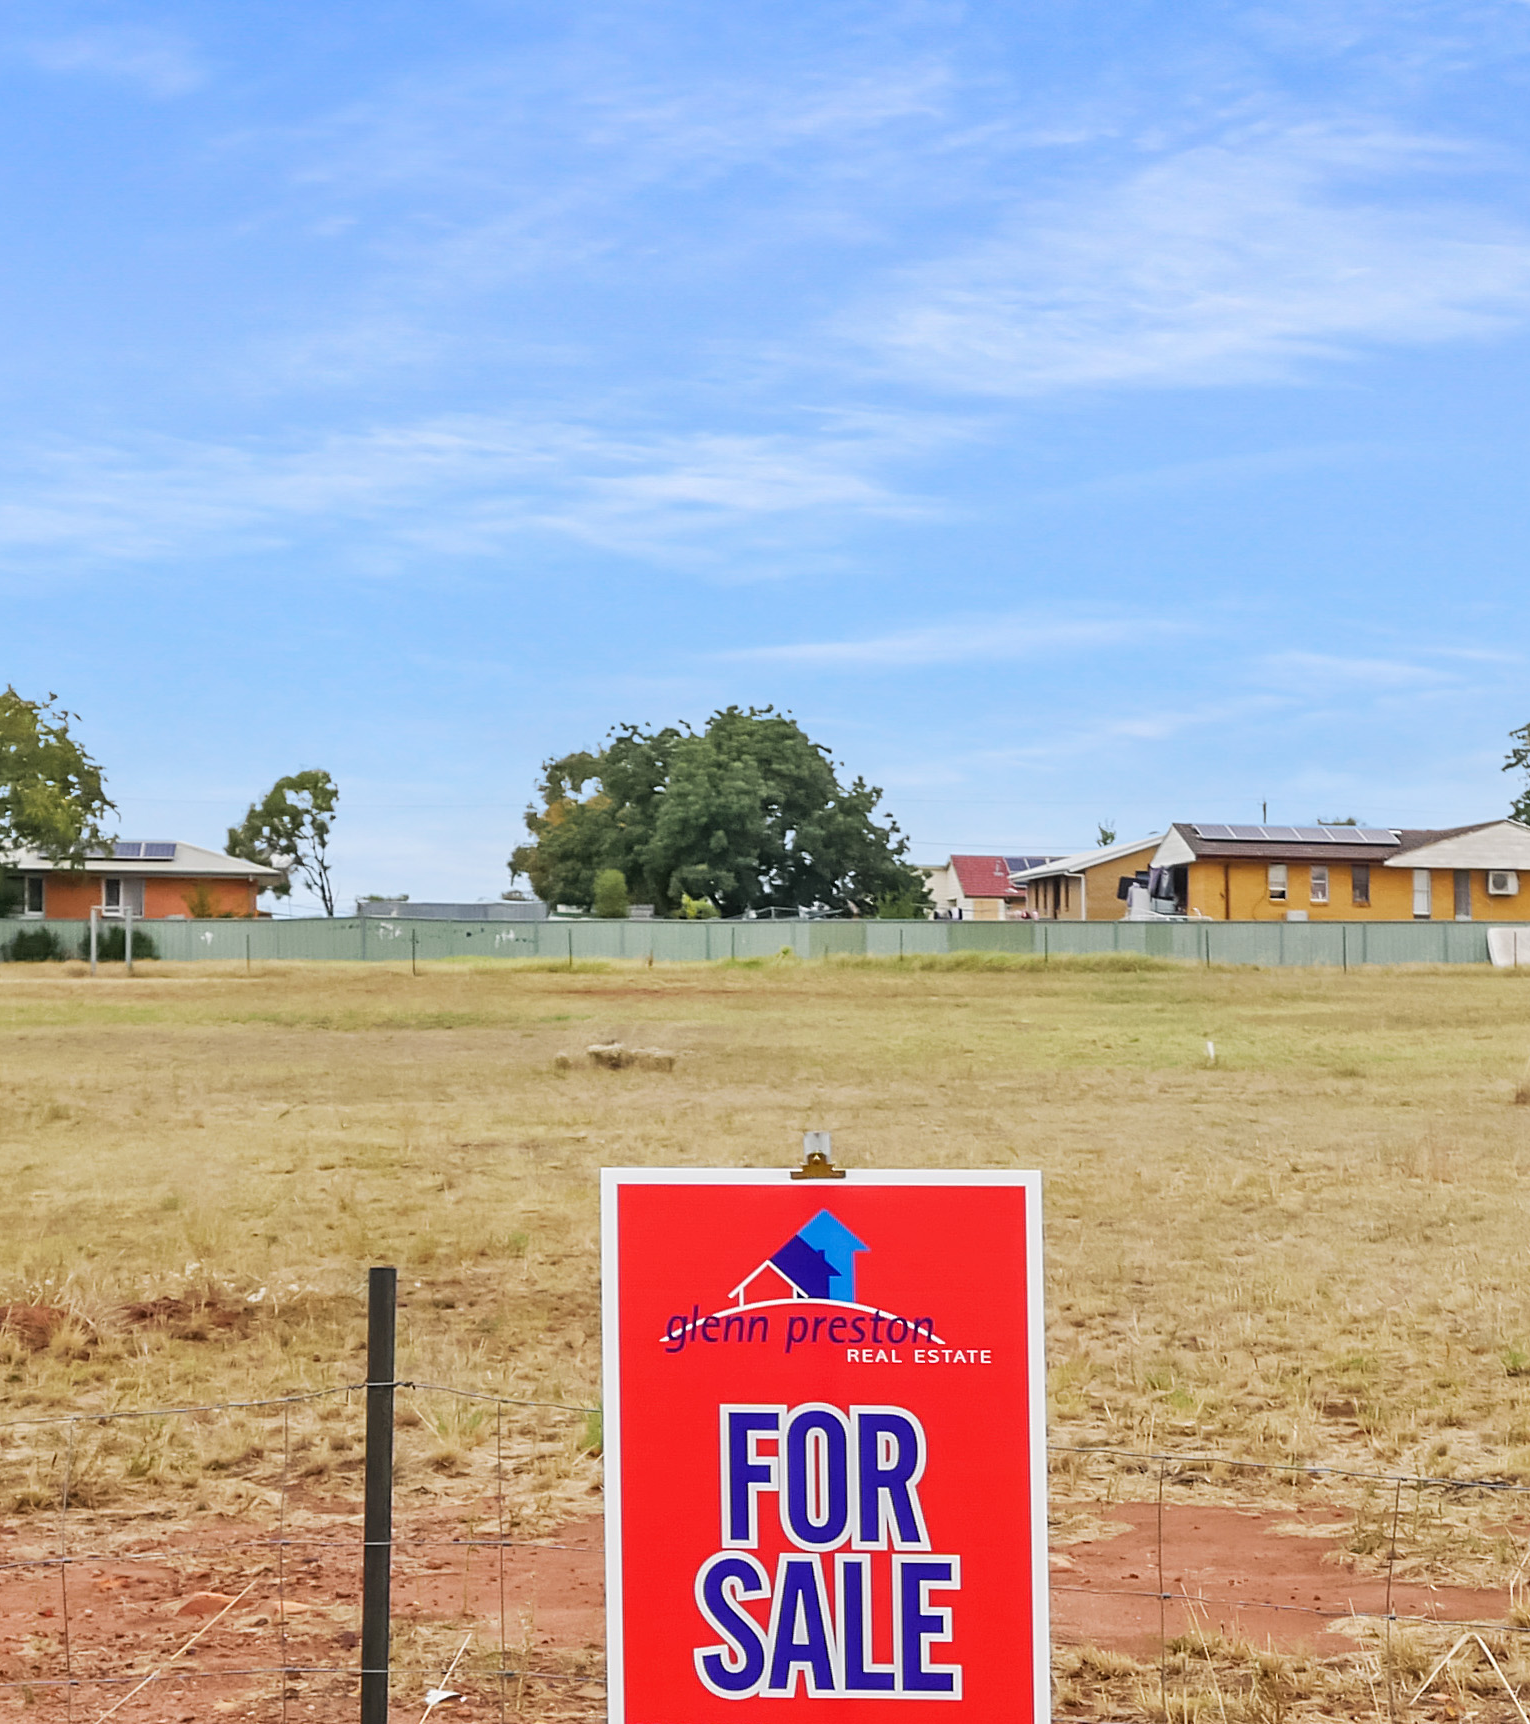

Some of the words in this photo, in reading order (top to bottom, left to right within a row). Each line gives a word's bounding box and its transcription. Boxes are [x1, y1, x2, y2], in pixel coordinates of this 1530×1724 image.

[665, 1305, 769, 1353] glenn
[785, 1310, 935, 1353] preston
[847, 1349, 903, 1364] REAL
[914, 1349, 992, 1365] ESTATE
[720, 1402, 930, 1551] FOR
[694, 1551, 962, 1699] SALE
